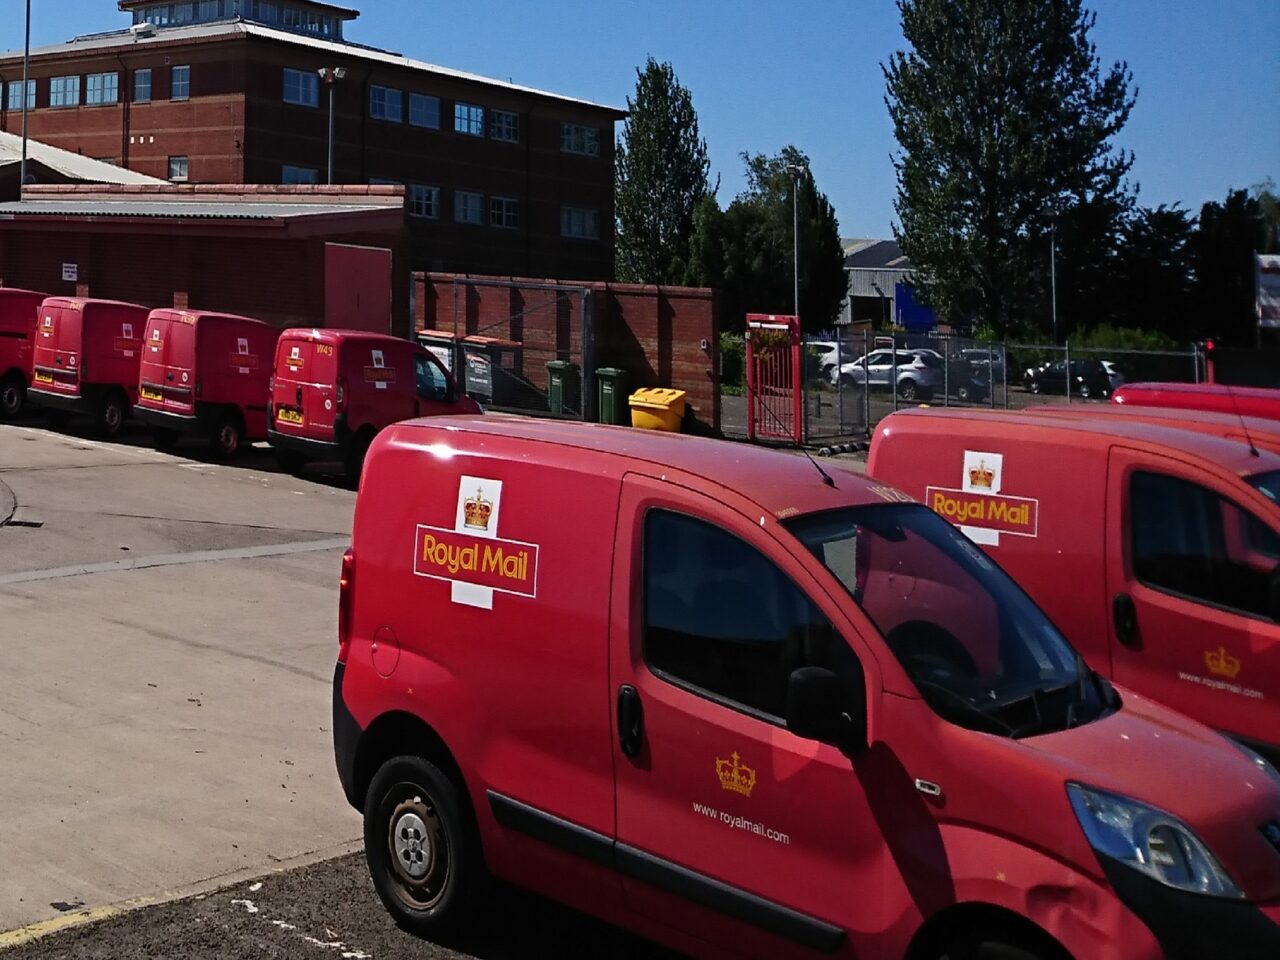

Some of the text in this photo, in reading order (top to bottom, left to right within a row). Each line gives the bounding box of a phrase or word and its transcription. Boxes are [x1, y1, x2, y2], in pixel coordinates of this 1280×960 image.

[933, 492, 1030, 526] Royal Mail
[422, 534, 528, 581] Royal Mail
[692, 801, 791, 845] www.royalmail.com
